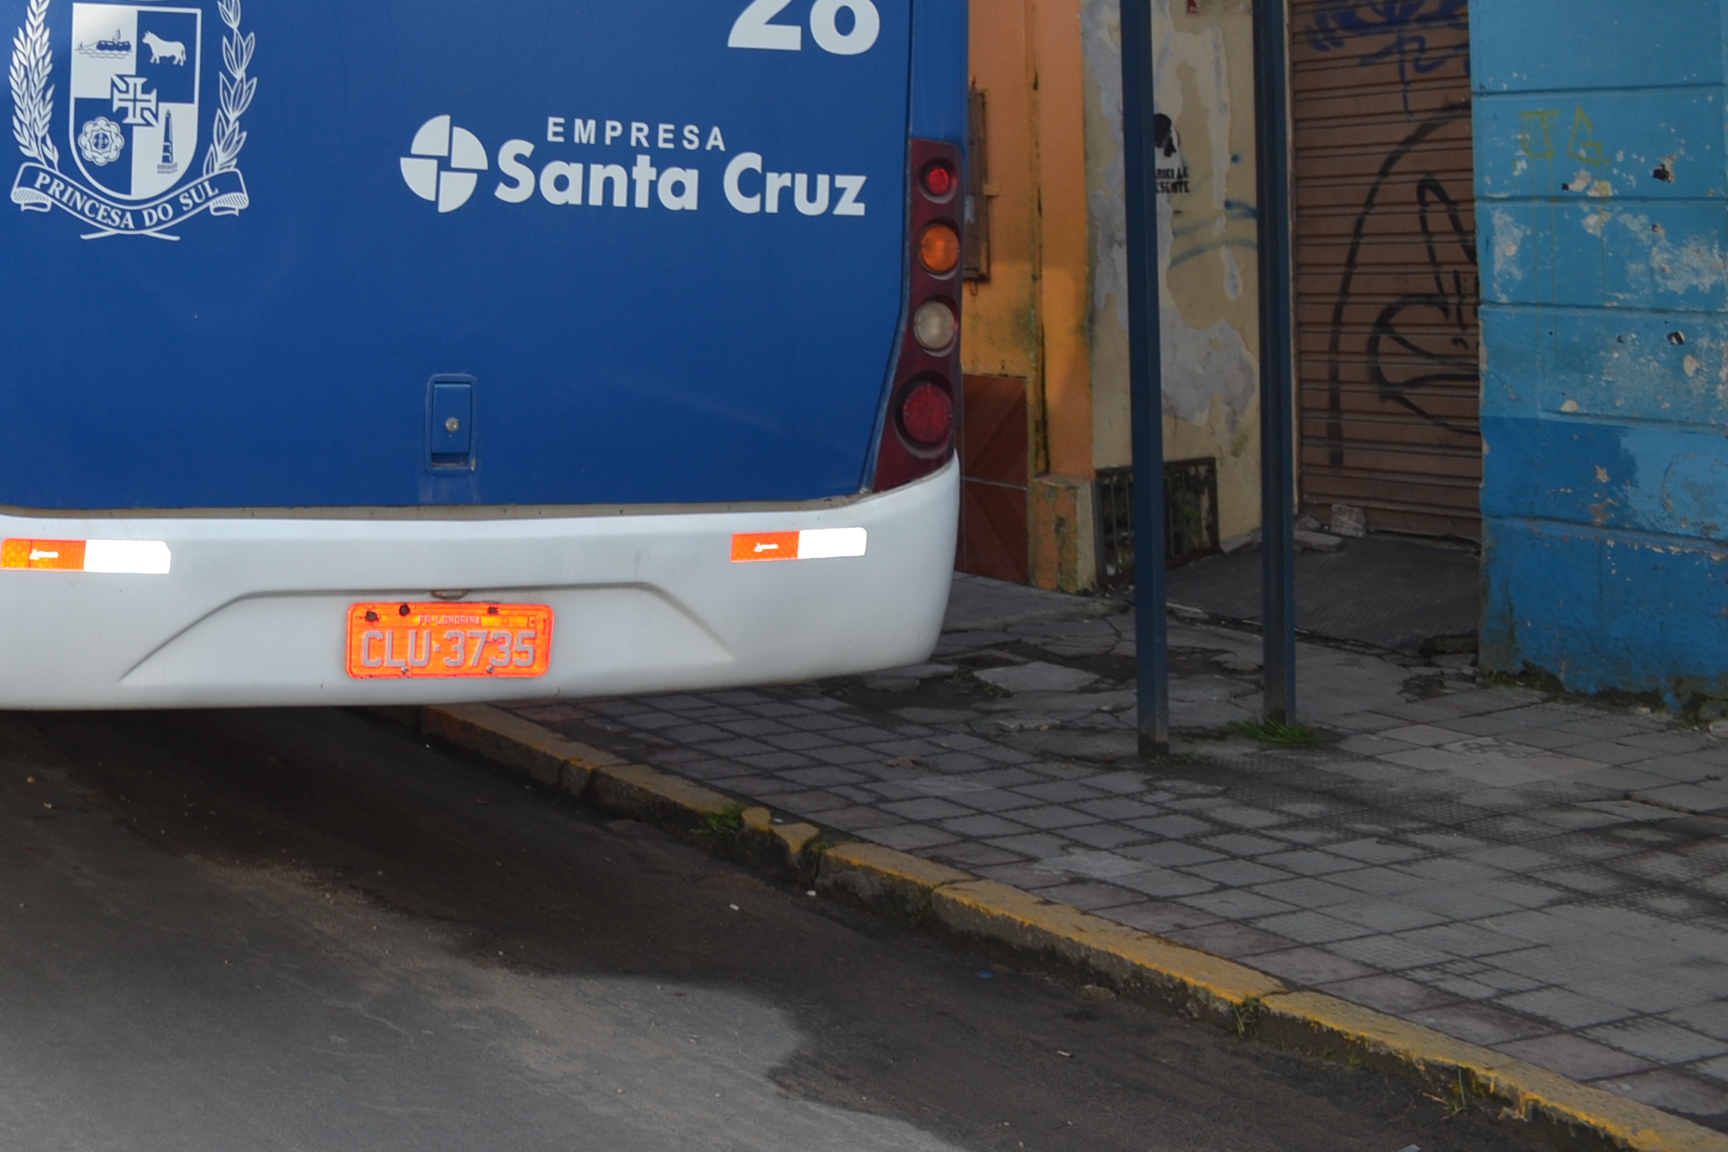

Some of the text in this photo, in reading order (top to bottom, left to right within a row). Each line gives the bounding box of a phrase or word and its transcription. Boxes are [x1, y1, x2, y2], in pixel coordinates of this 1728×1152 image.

[546, 116, 726, 152] EMPRESA
[33, 171, 220, 229] PRINCESA DO SUL
[494, 138, 867, 217] Santa Cruz
